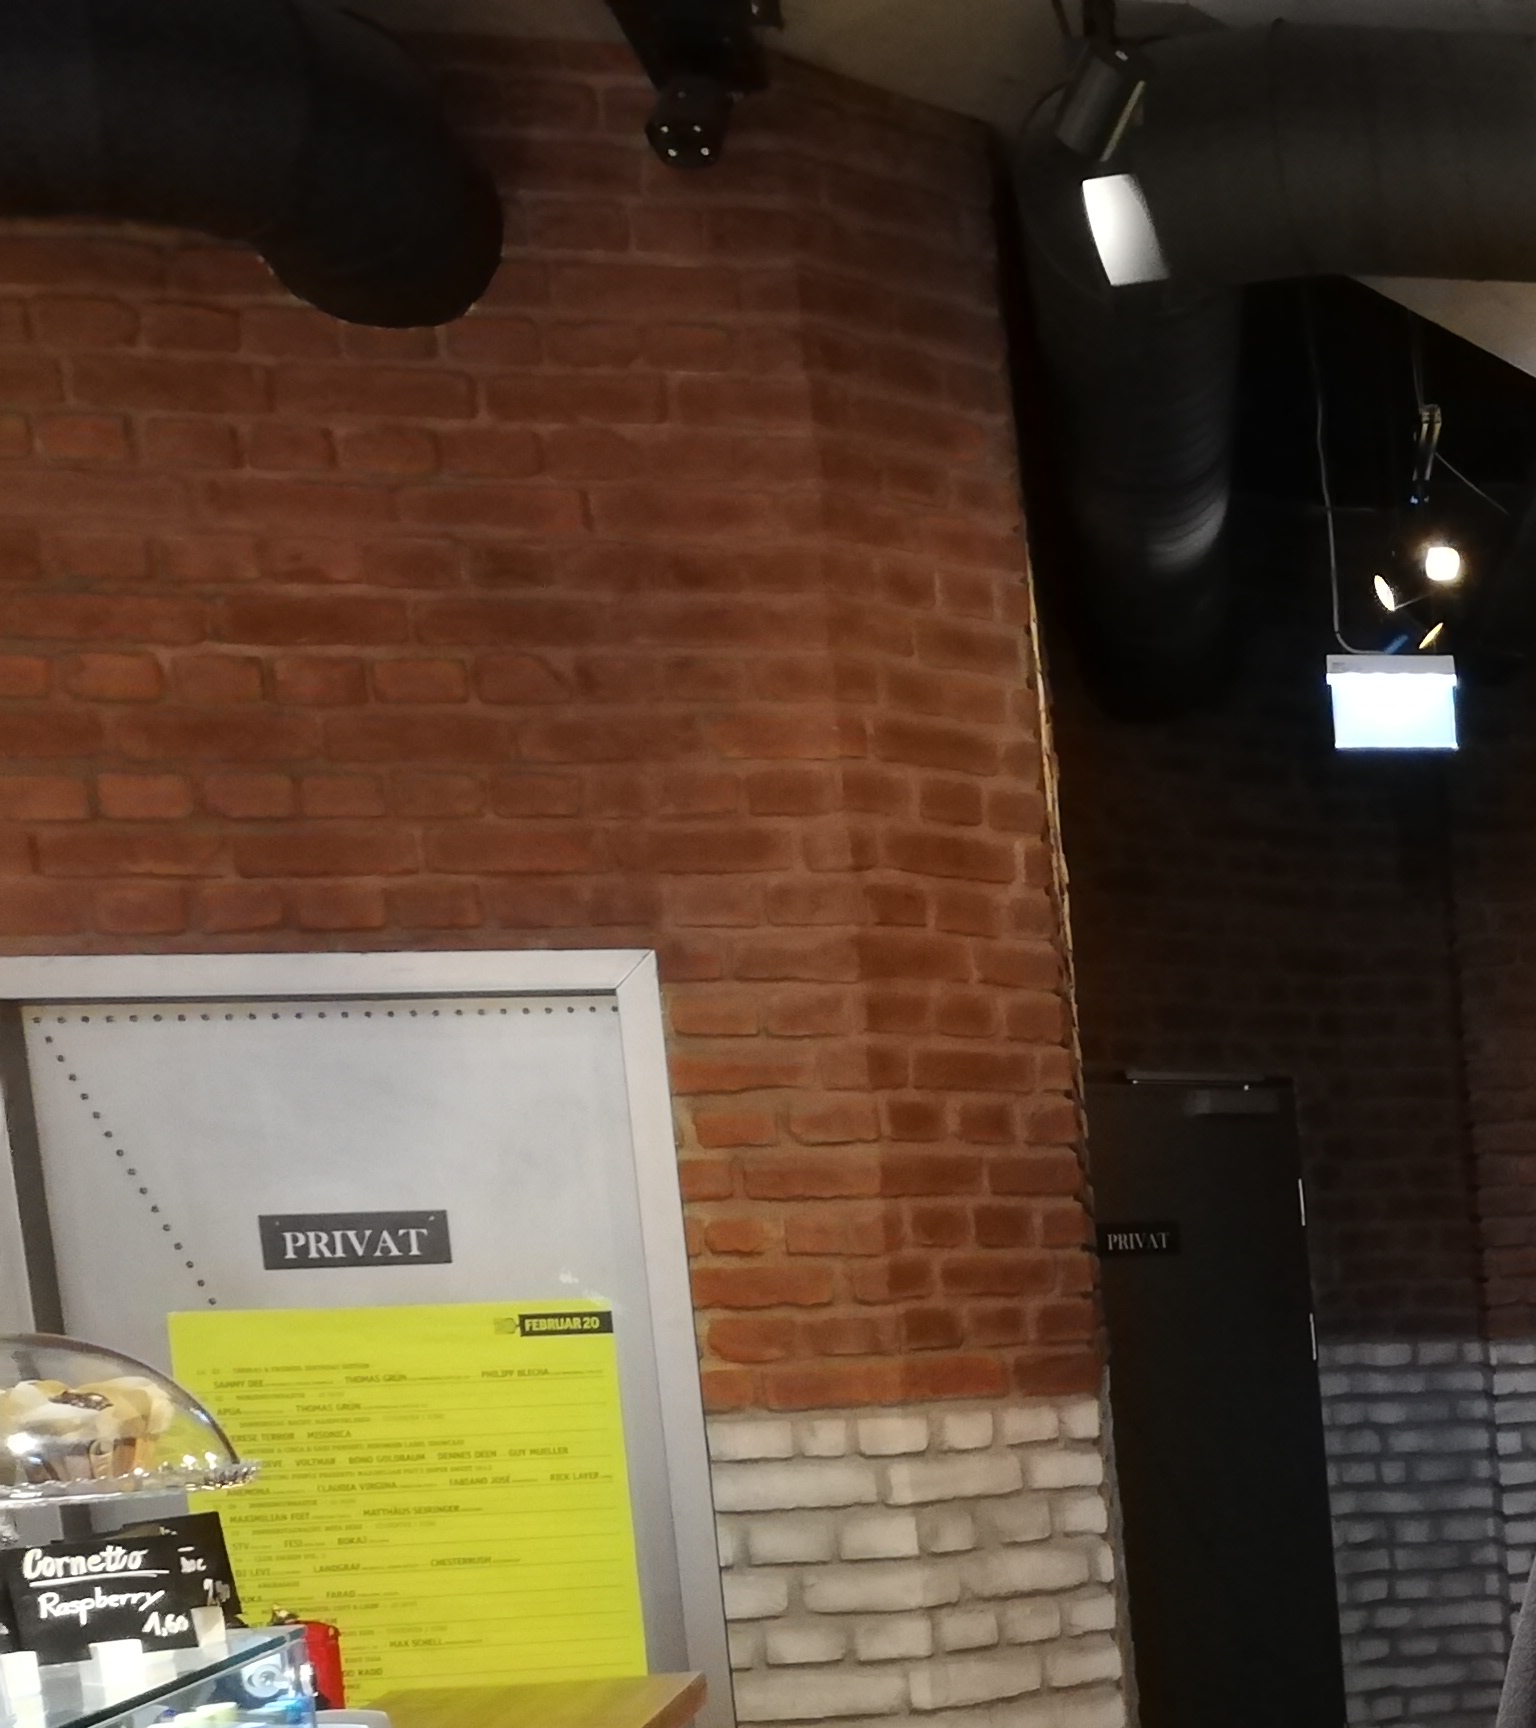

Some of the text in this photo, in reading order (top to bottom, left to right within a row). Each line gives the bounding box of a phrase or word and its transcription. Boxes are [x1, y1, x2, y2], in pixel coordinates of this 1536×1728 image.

[281, 1228, 428, 1259] PRIVAT
[1106, 1231, 1170, 1251] PRIVAT
[524, 1316, 600, 1332] FEBRUAR 20
[344, 1374, 381, 1384] THOMAS
[481, 1369, 515, 1379] PHILIPP
[296, 1403, 333, 1413] THOMAS
[375, 1453, 426, 1463] GOLDBAUM
[508, 1446, 569, 1458] GUY MUELLER
[22, 1545, 150, 1581] Cornetto
[38, 1586, 166, 1627] Raspberry
[389, 1640, 410, 1649] MAX
